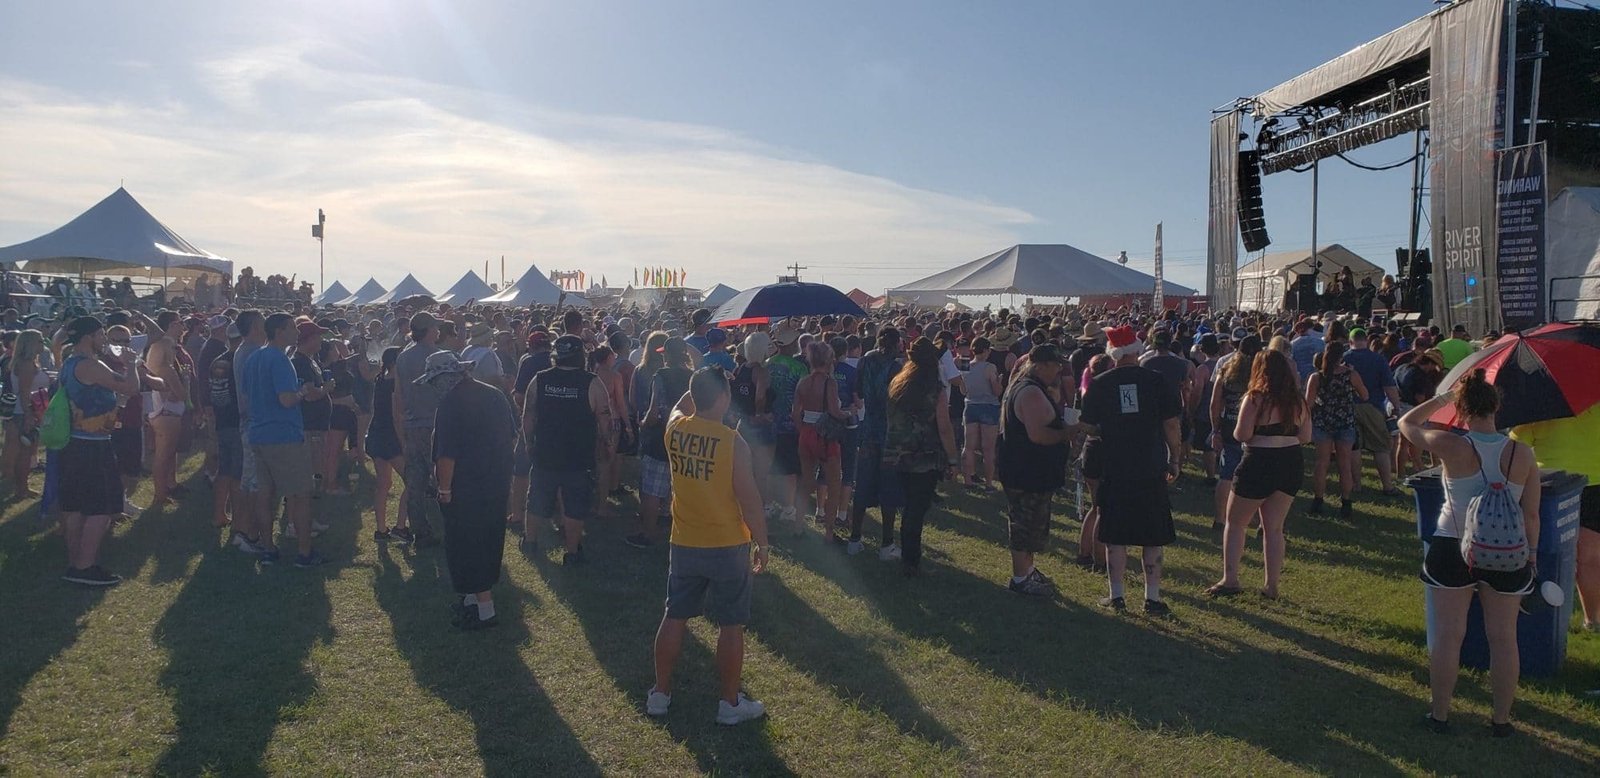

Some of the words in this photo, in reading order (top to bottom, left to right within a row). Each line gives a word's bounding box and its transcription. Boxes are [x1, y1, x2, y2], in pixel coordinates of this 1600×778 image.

[1445, 226, 1481, 248] RIVER
[1446, 248, 1480, 270] SPIRIT
[670, 430, 720, 459] EVENT
[671, 453, 715, 481] STAFF
